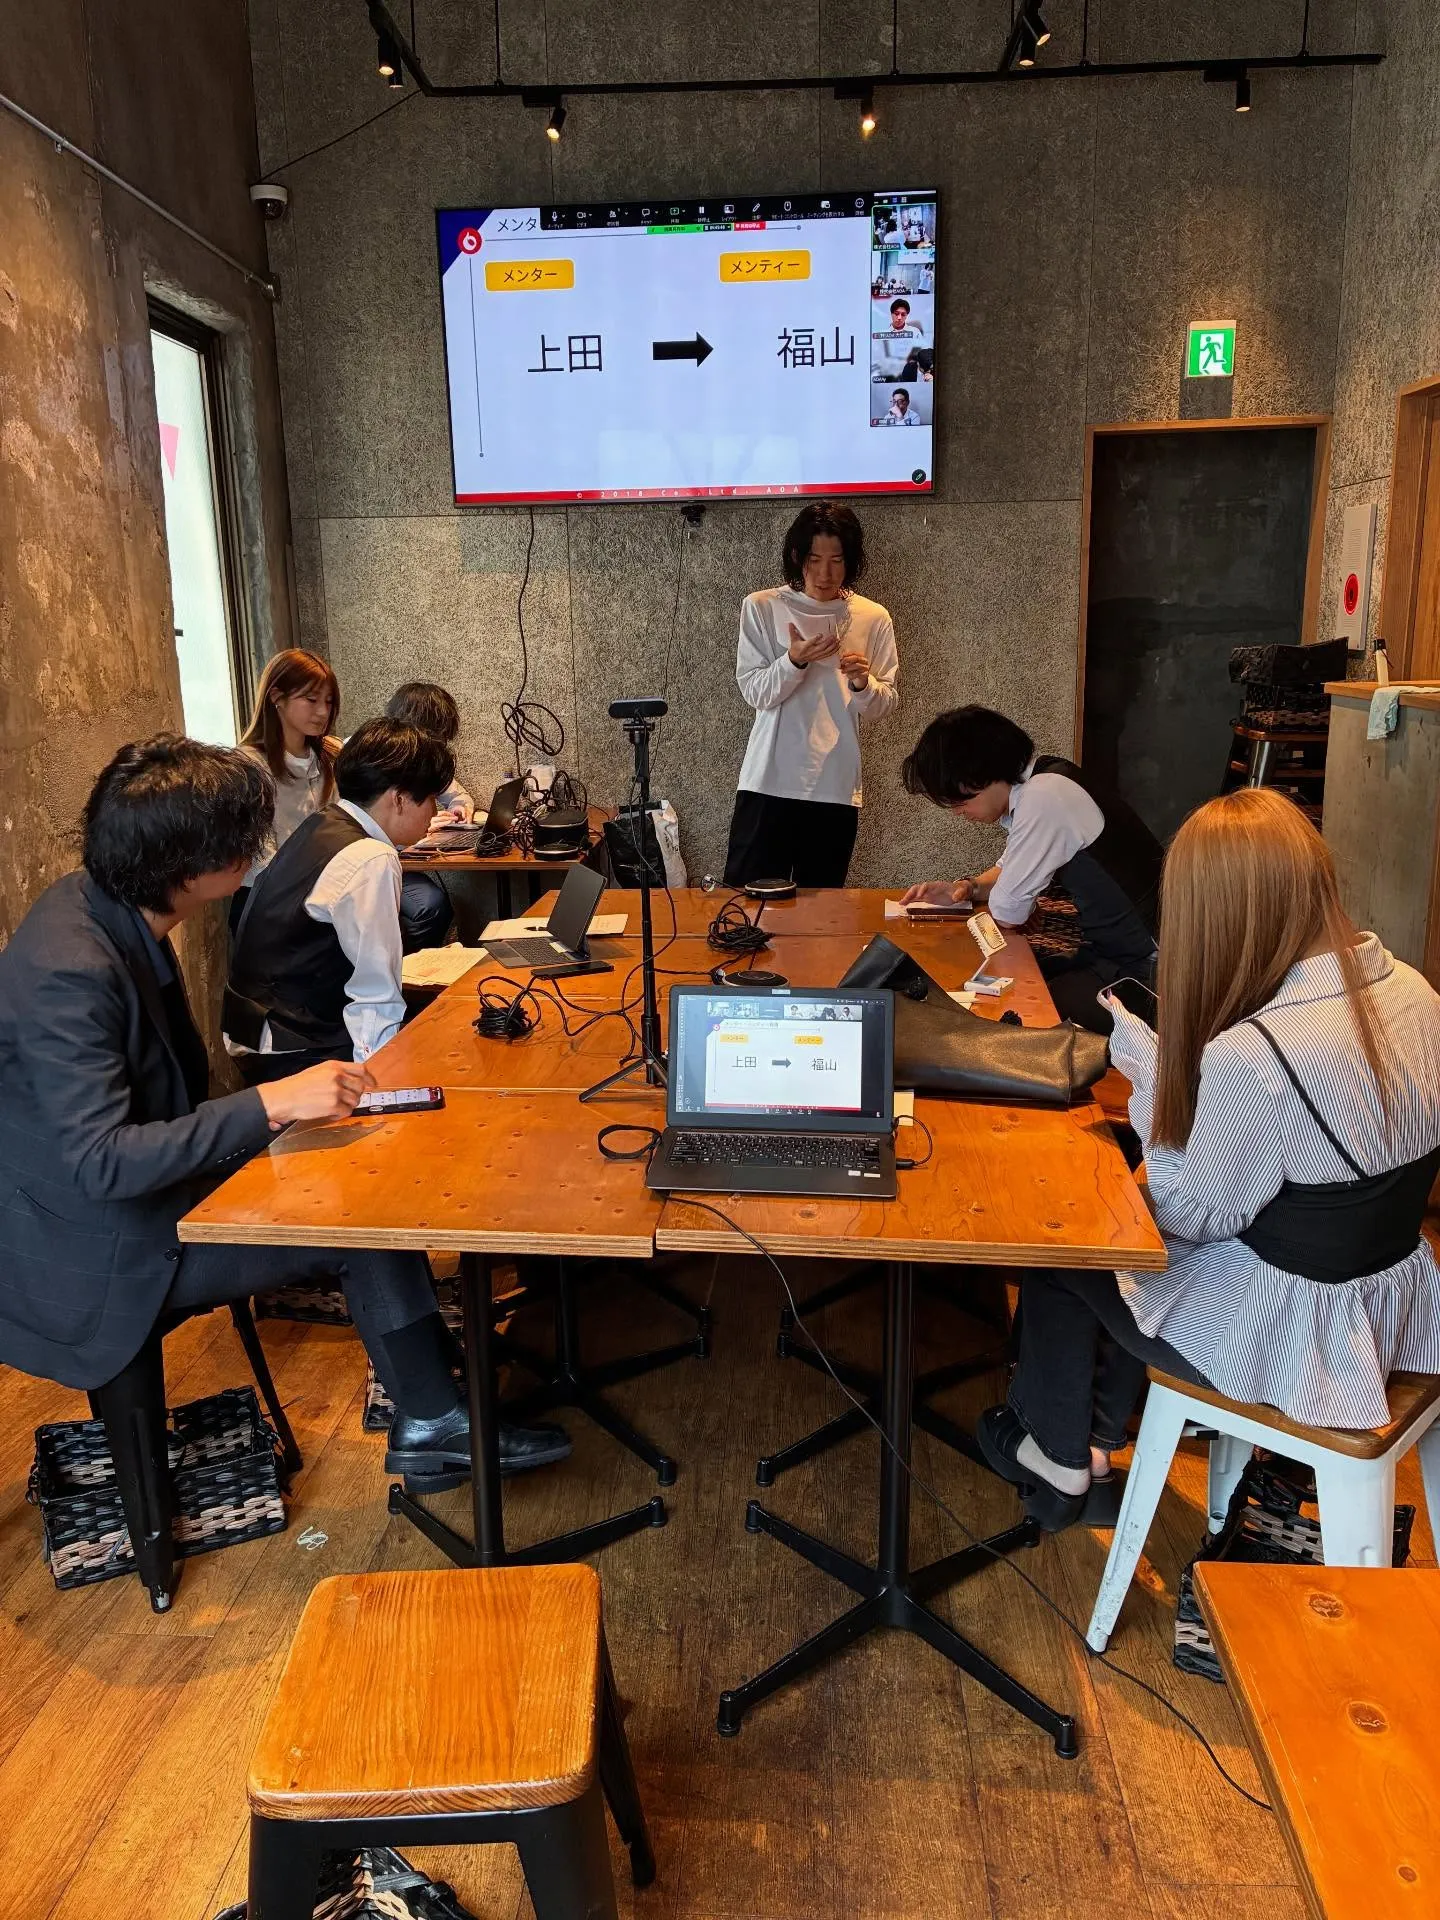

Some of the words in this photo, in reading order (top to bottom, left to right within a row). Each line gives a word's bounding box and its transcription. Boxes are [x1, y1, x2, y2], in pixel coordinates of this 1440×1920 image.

[498, 216, 537, 233] メンタ
[731, 259, 800, 274] メンティー
[503, 267, 558, 283] メンター
[527, 334, 602, 373] 上田
[776, 326, 855, 368] 福山
[600, 490, 643, 498] 2018
[765, 485, 799, 493] AOA
[731, 1055, 757, 1068] 上田
[811, 1057, 837, 1071] 福山
